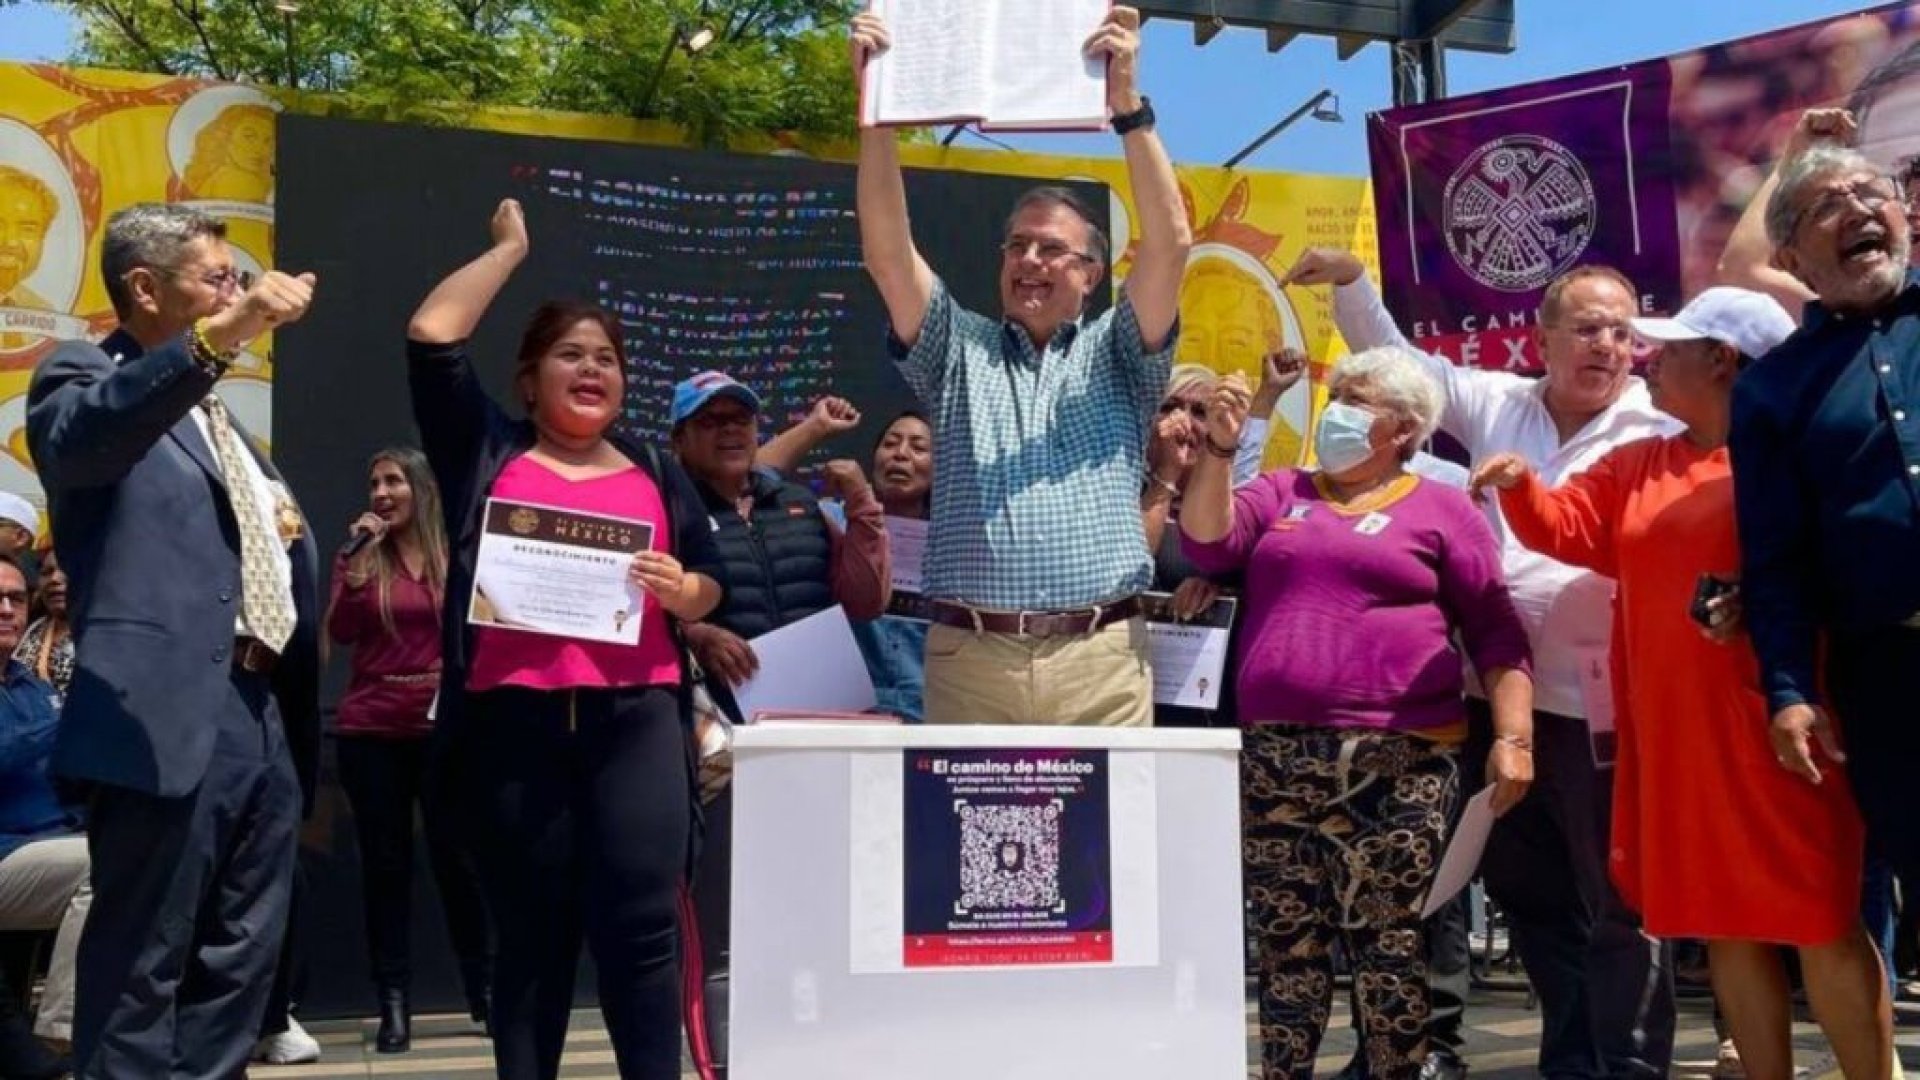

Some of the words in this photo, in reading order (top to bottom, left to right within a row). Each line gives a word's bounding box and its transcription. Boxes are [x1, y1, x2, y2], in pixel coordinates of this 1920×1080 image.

[1413, 320, 1441, 339] EL
[932, 758, 948, 775] El
[951, 758, 1012, 774] camino
[1014, 758, 1034, 774] de
[1036, 758, 1094, 774] México
